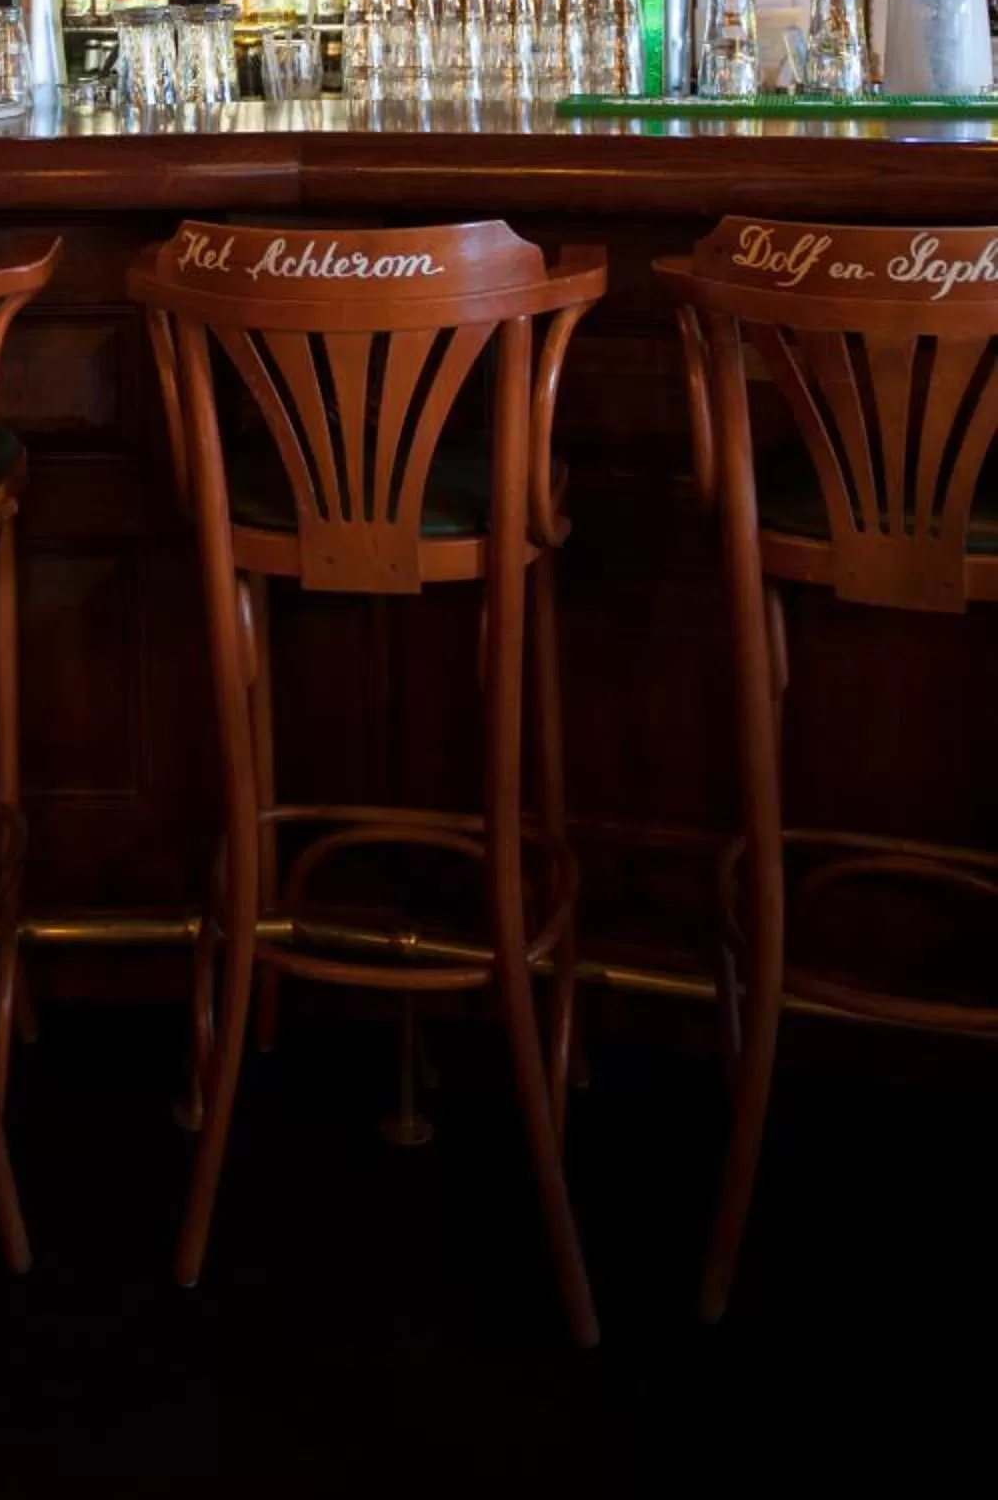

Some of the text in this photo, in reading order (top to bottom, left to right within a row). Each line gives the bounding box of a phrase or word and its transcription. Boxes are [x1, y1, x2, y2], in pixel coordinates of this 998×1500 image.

[178, 230, 444, 281] Het Achterom
[732, 225, 833, 287] Dolf
[829, 262, 875, 280] en
